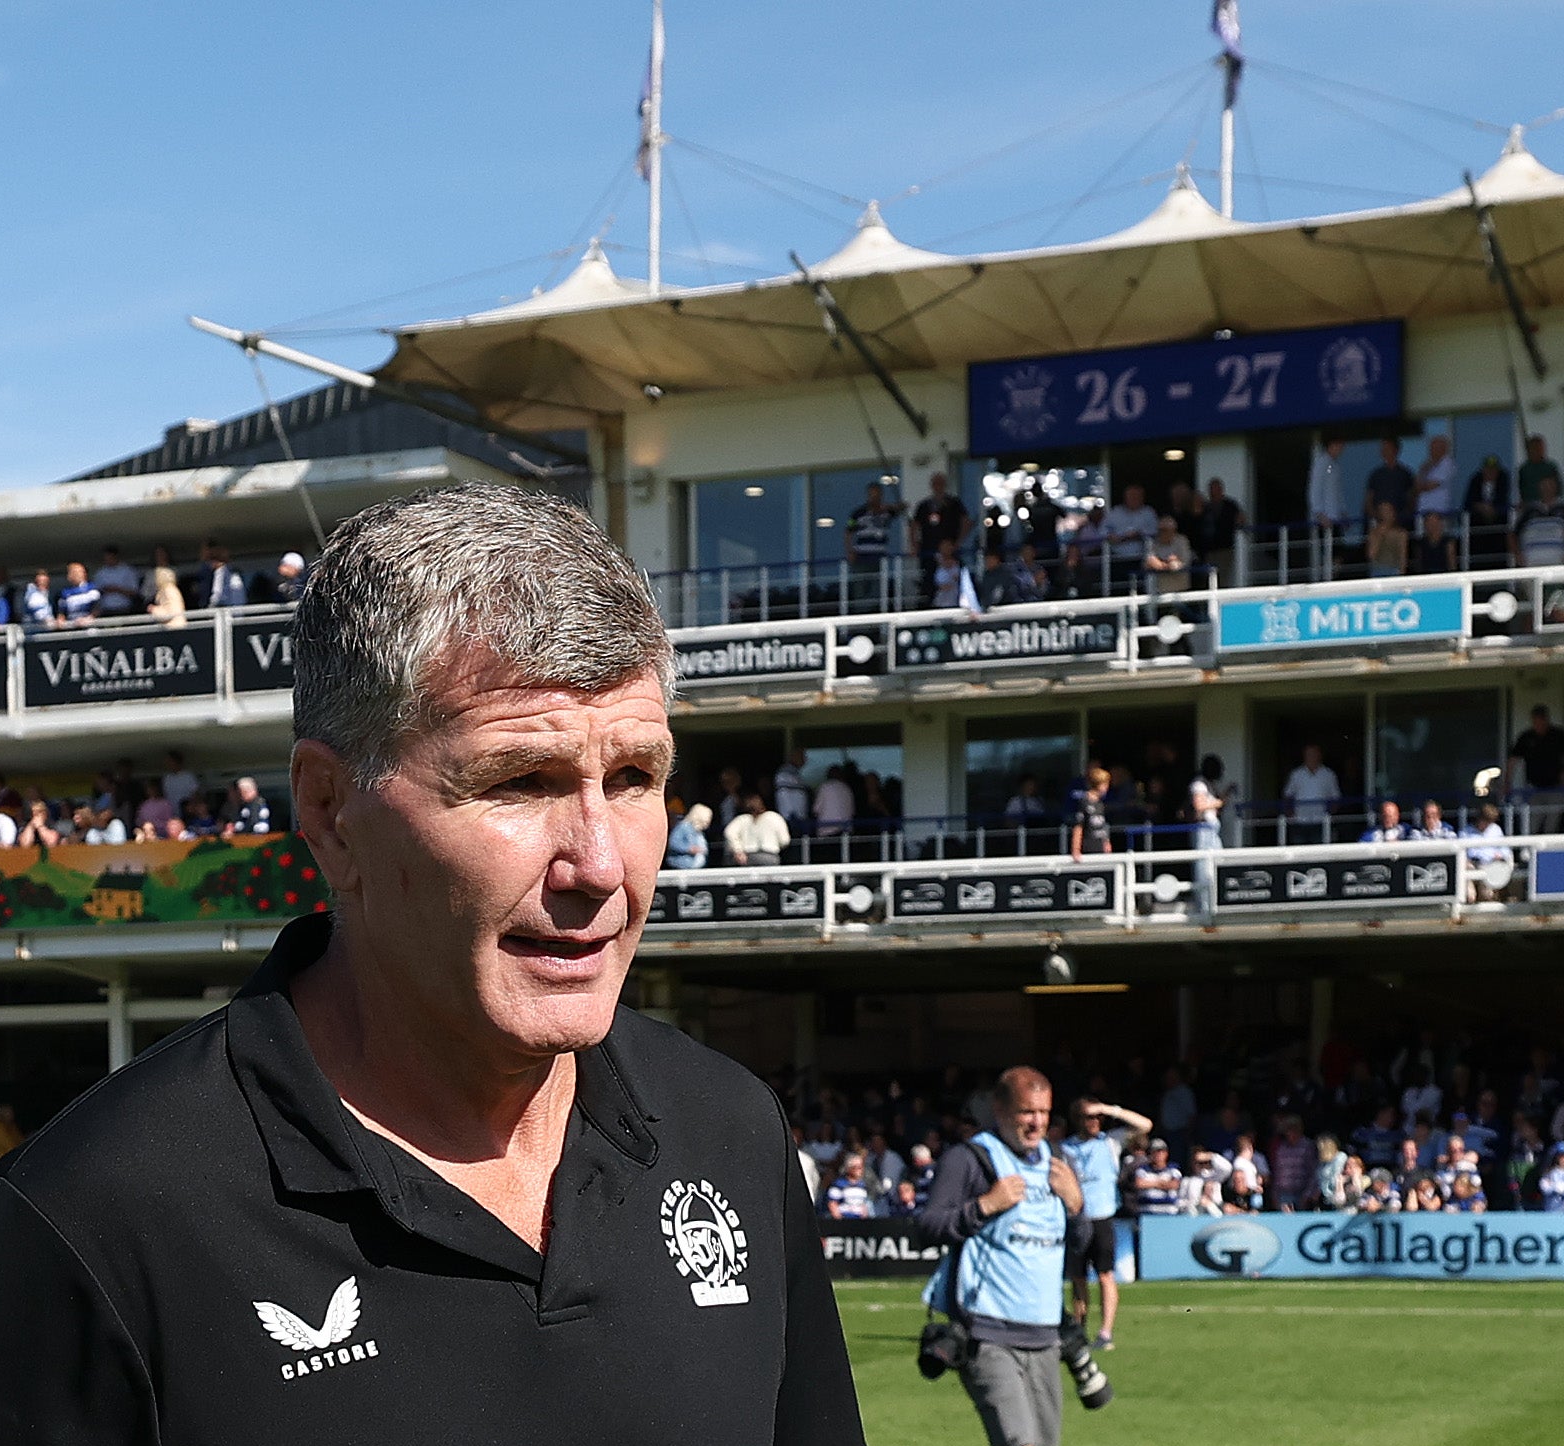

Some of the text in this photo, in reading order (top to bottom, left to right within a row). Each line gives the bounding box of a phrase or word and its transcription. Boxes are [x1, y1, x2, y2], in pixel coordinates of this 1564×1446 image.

[1075, 369, 1146, 425] 26
[1216, 352, 1285, 413] 27
[1308, 598, 1421, 636] MiTEQ
[950, 618, 1113, 658] wealthtime
[40, 643, 199, 687] VIÑALBA
[281, 1340, 379, 1380] CASTORE
